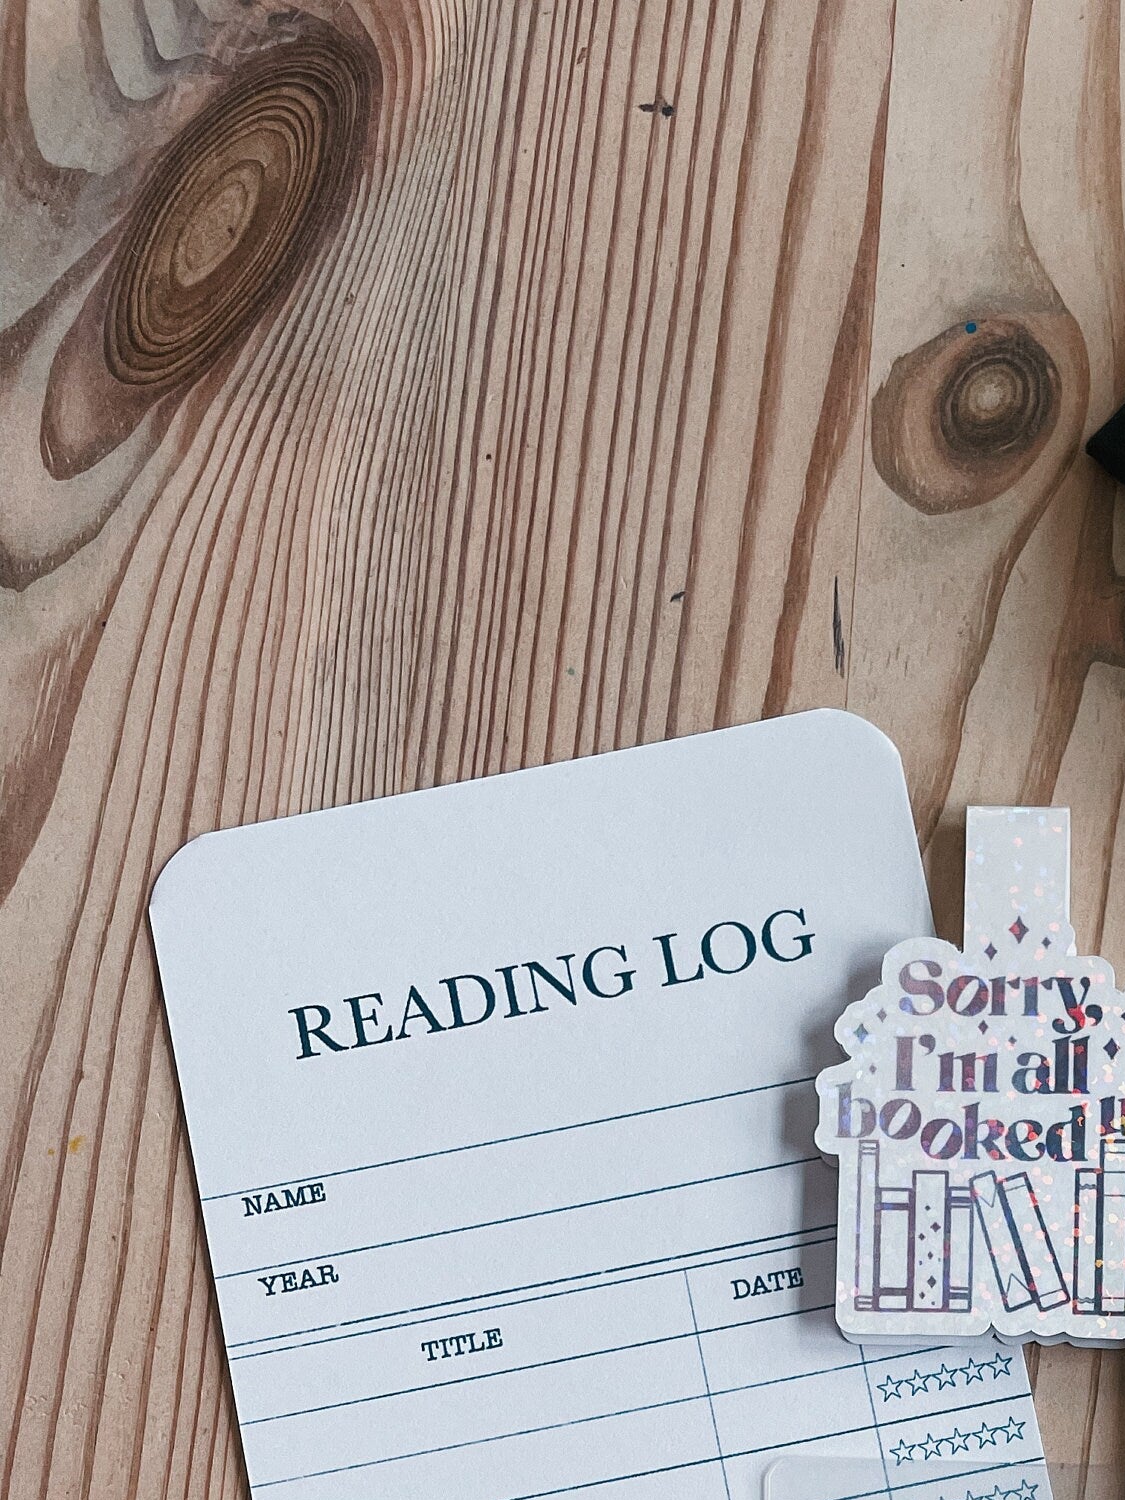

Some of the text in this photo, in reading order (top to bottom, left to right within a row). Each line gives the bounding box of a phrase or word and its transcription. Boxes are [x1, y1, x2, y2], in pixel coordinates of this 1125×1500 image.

[289, 908, 816, 1060] READING LOG
[899, 959, 1104, 1035] Sorry,
[894, 1034, 1091, 1095] I’m all
[833, 1081, 1090, 1163] booked
[242, 1182, 327, 1217] NAME
[257, 1263, 340, 1297] YEAR
[730, 1266, 805, 1300] DATE
[421, 1327, 504, 1362] TITLE
